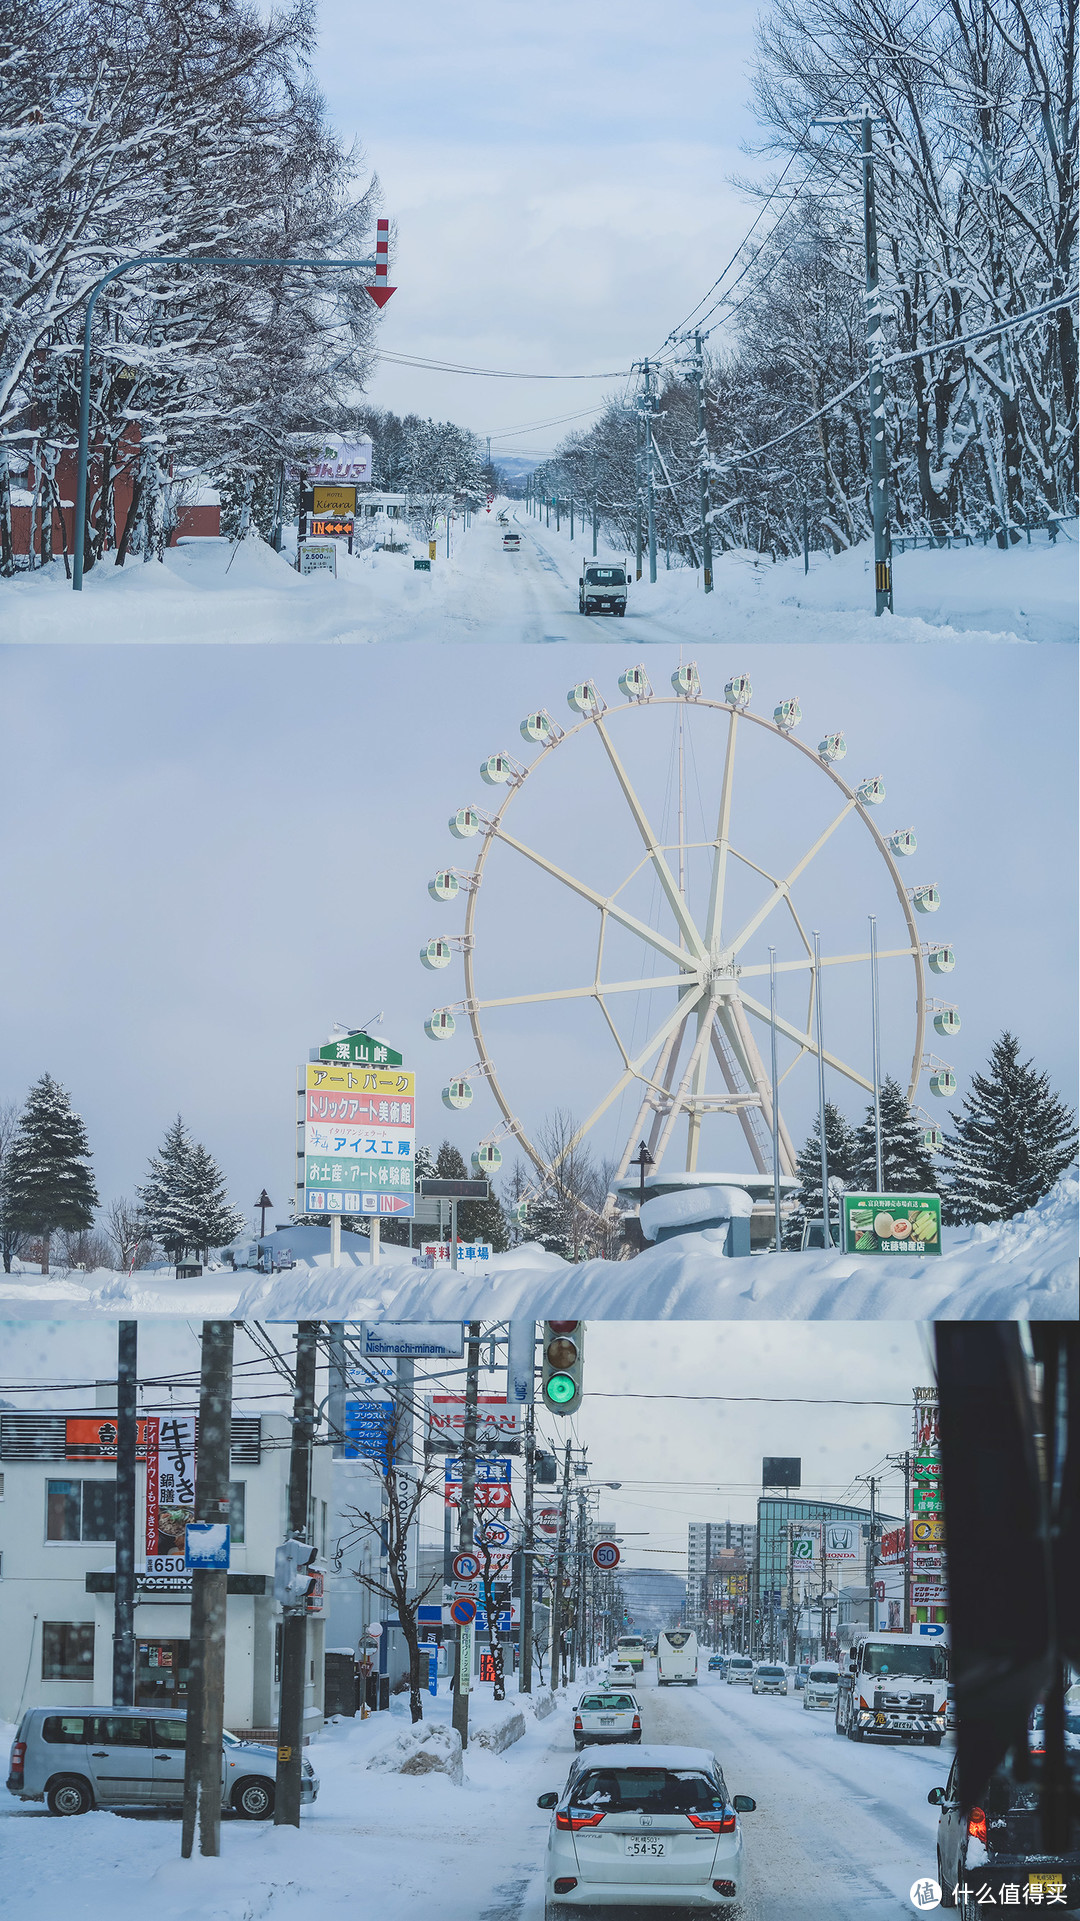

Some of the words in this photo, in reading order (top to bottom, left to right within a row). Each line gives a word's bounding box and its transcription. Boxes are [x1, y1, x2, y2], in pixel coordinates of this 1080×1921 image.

[316, 500, 353, 509] Kirara
[312, 521, 325, 535] IN
[336, 1042, 388, 1063] 深山峠
[314, 1070, 409, 1092] アートパーク
[309, 1095, 412, 1124] トリックアート美術館
[329, 1127, 387, 1137] イタリアンジェラート
[334, 1137, 411, 1156] アイス工房
[309, 1162, 411, 1186] お土産・アート体験館
[381, 1195, 393, 1211] IN
[881, 1240, 925, 1252] 佐藤物産店
[366, 1342, 445, 1354] Nishimachi-minami
[429, 1415, 515, 1428] NISAN
[160, 1420, 196, 1504] 牛すき
[160, 1473, 175, 1503] 鍋膳
[448, 1486, 509, 1506] あさひ
[482, 1531, 505, 1540] sso
[598, 1549, 615, 1562] 50
[480, 1612, 506, 1621] セフ
[483, 1622, 503, 1630] 2H
